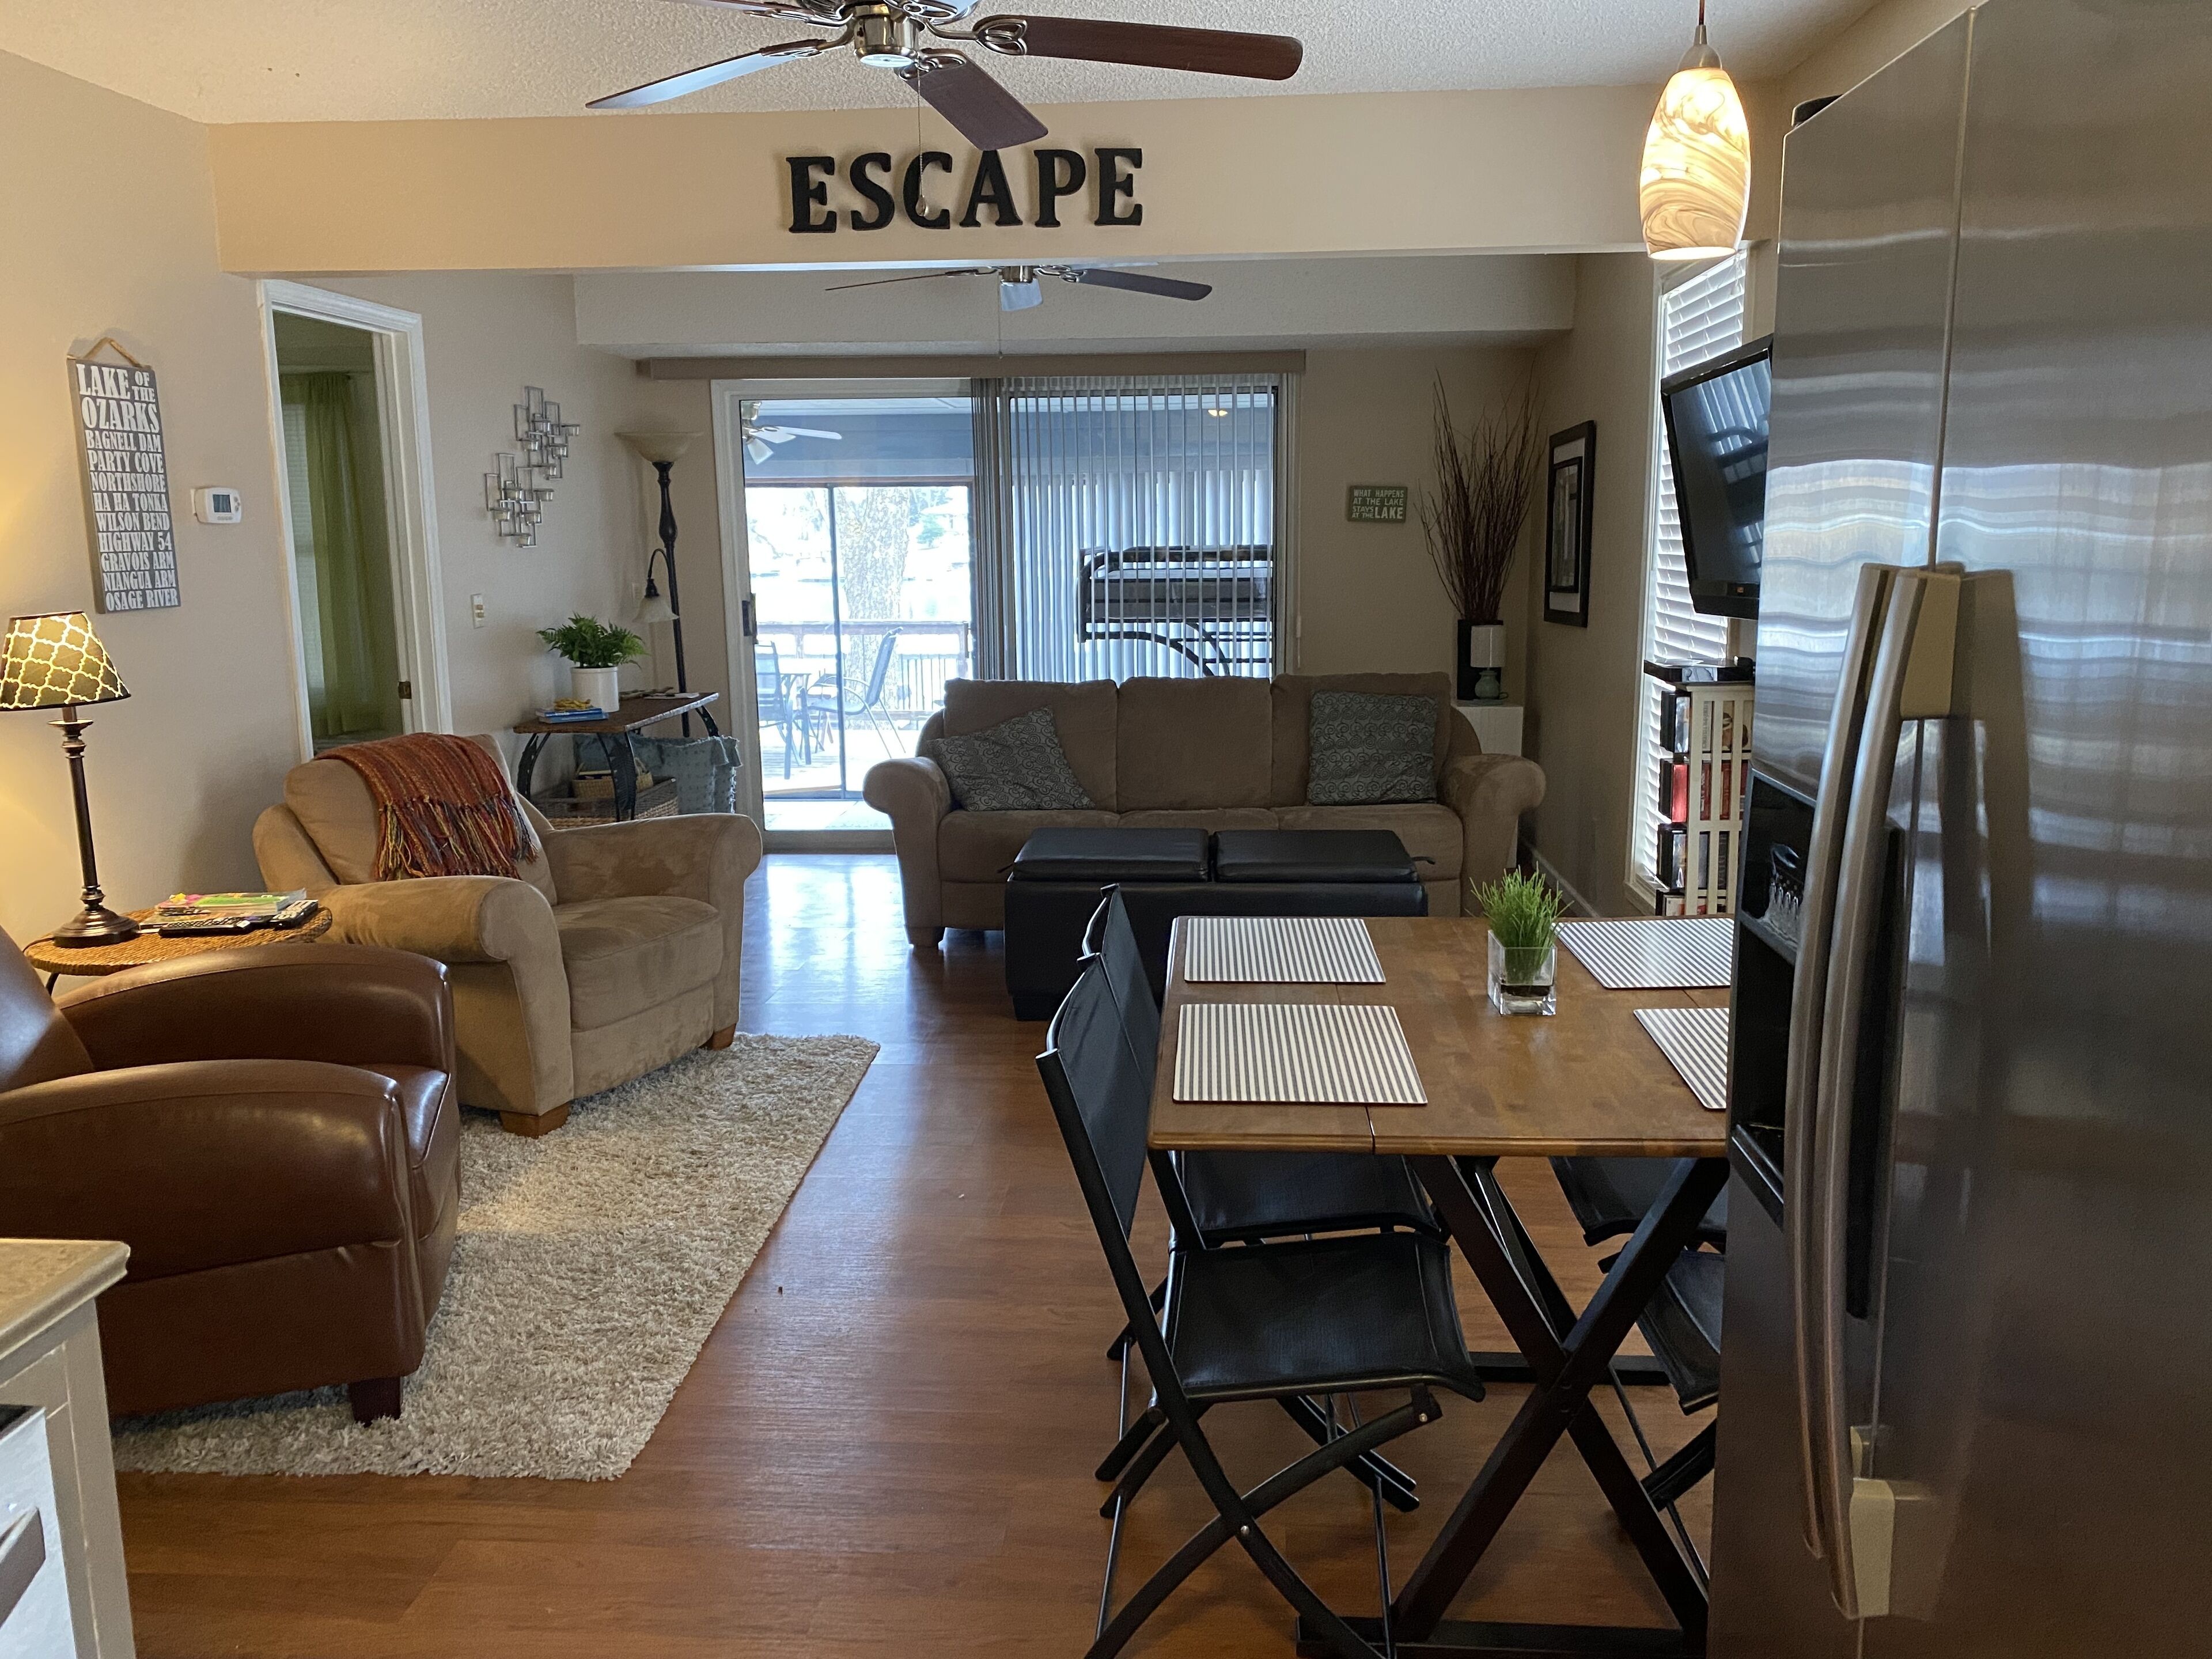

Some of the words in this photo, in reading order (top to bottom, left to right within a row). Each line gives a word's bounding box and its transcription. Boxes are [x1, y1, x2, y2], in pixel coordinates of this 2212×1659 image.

[786, 147, 1143, 233] ESCAPE
[76, 363, 131, 400] LAKE
[135, 371, 150, 387] OF
[131, 386, 156, 402] THE
[81, 396, 160, 433] OZARKS
[85, 430, 137, 451] BAGNELL
[138, 433, 162, 452] DAM
[88, 450, 131, 472] PARTY
[134, 452, 164, 474] COVE
[90, 472, 166, 493] NORTHSHORE
[1354, 488, 1372, 497] WHAT
[1375, 489, 1404, 498] HAPPENS
[93, 493, 111, 512] HA
[112, 493, 131, 512] HA
[132, 493, 168, 512] TONKA
[1353, 497, 1362, 505] AT
[1366, 498, 1381, 506] THE
[96, 512, 140, 531] WILSON
[142, 512, 170, 531] BEND
[1374, 506, 1403, 519] LAKE
[98, 532, 154, 552] HIGHWAY
[157, 531, 172, 551] 54
[101, 552, 150, 572] GRAVOIS
[153, 551, 175, 570] ARM
[103, 570, 152, 592] NIANGUA
[154, 570, 176, 588] ARM
[105, 590, 144, 612] OSAGE
[146, 588, 178, 608] RIVER
